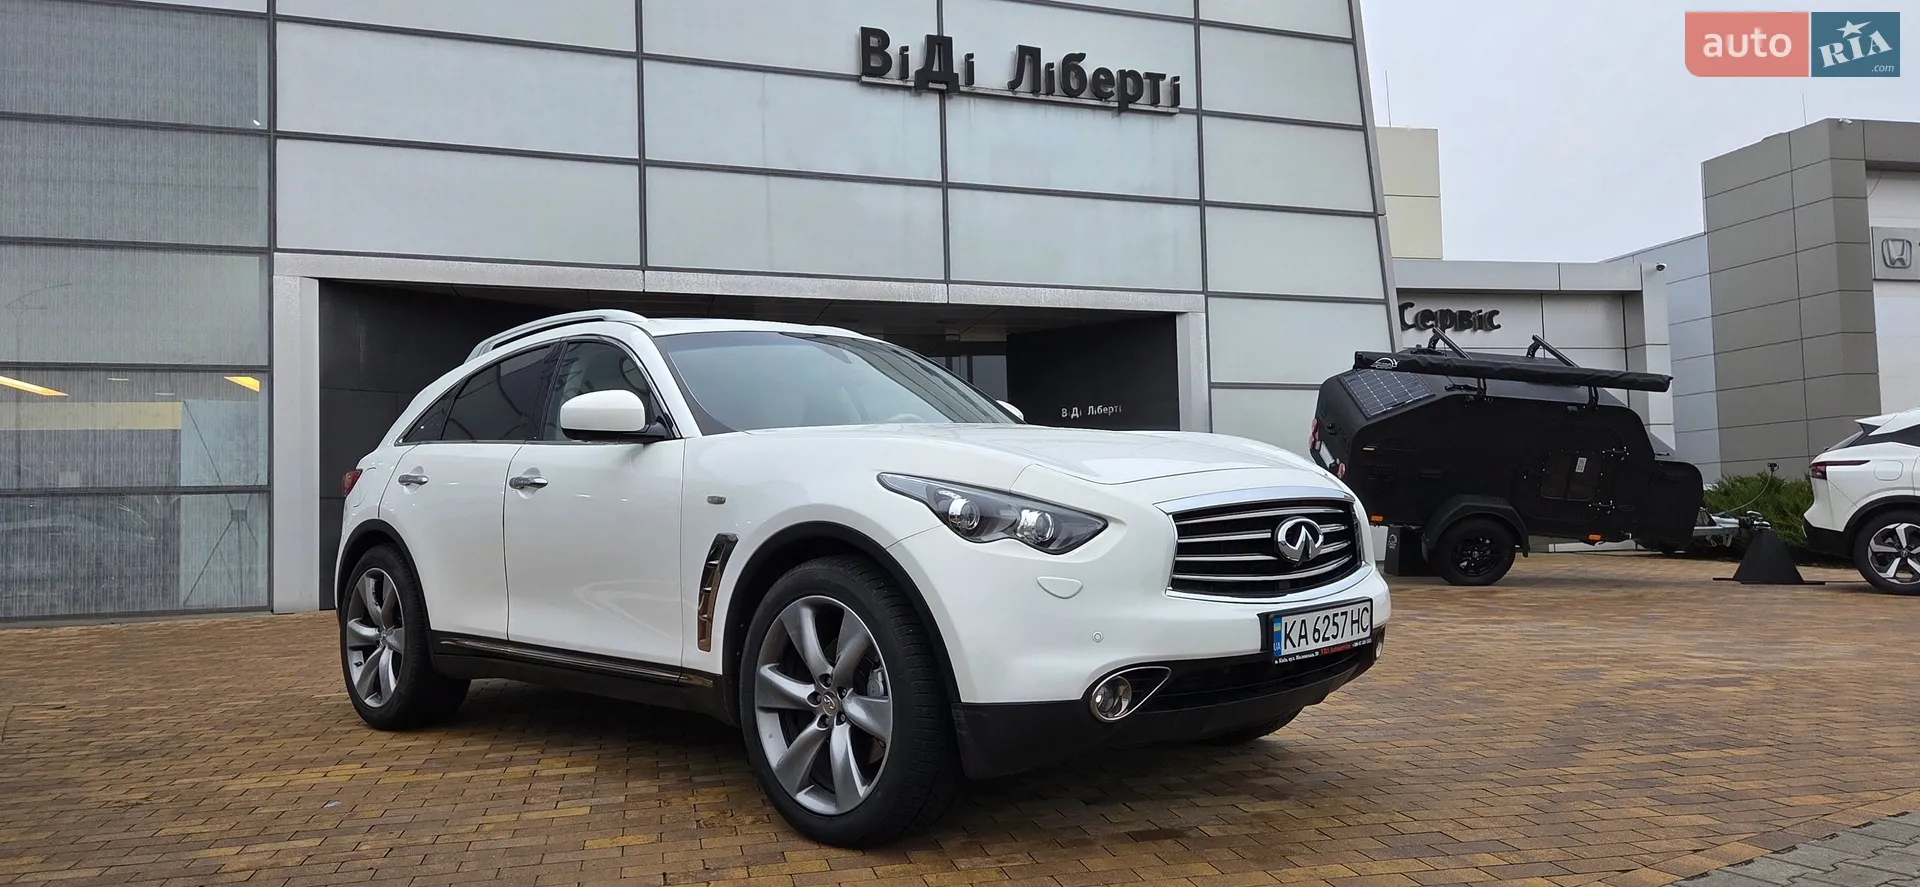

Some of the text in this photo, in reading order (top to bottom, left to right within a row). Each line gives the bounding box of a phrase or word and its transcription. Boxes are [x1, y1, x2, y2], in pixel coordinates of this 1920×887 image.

[859, 26, 1181, 114] ВіДі Ліберті
[1398, 301, 1501, 334] Сервіс
[1087, 404, 1122, 416] Ліберті
[1284, 619, 1309, 650] KA
[1312, 610, 1348, 643] 6257
